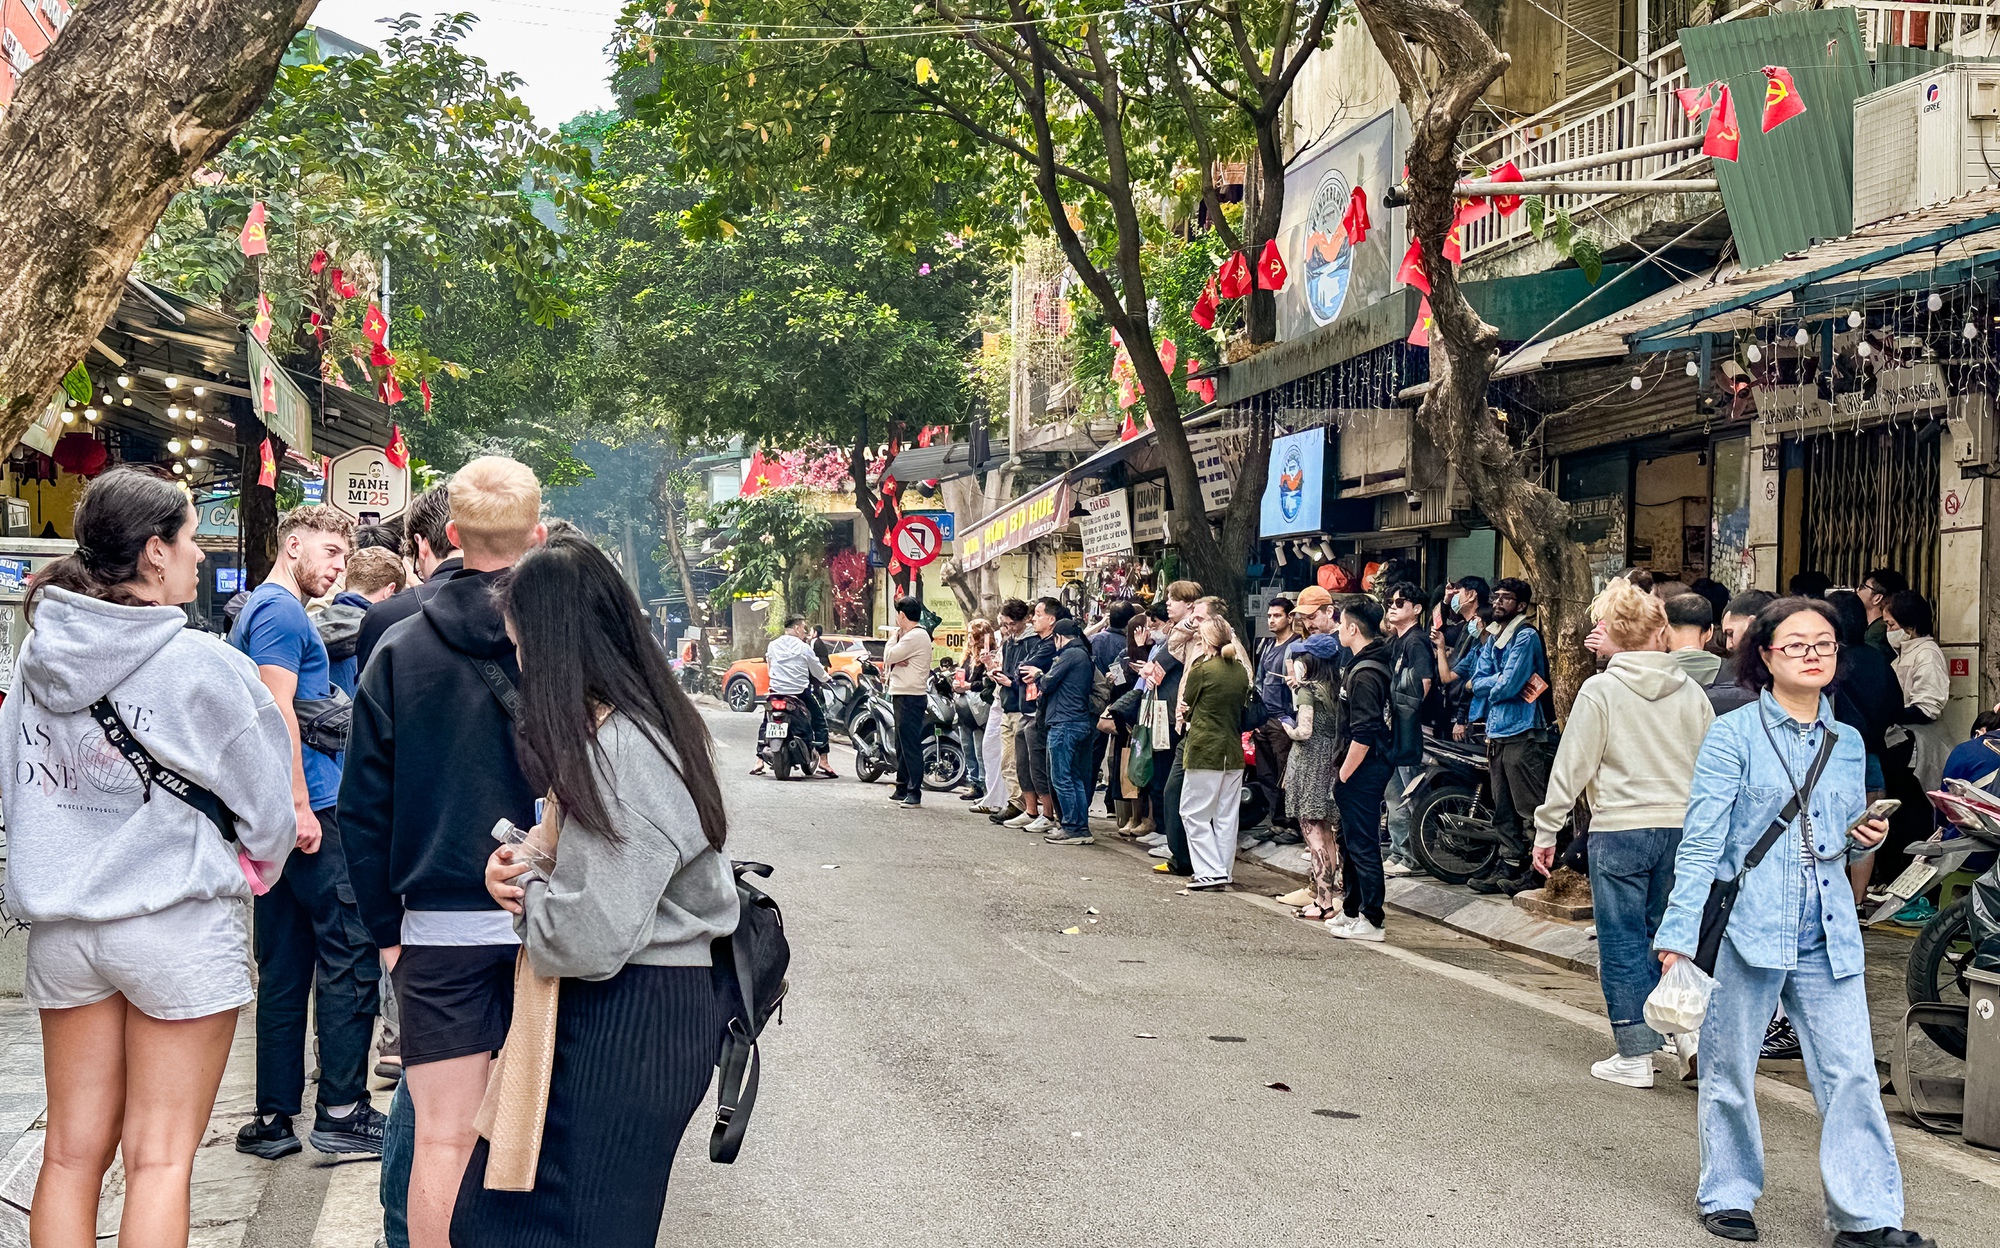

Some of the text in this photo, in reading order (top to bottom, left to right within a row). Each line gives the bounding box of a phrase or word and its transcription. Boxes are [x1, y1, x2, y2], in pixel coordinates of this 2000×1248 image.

[348, 478, 389, 490] BANH
[16, 760, 78, 791] ONE
[86, 806, 119, 814] REPUBLIC
[352, 1122, 383, 1138] HOKA
